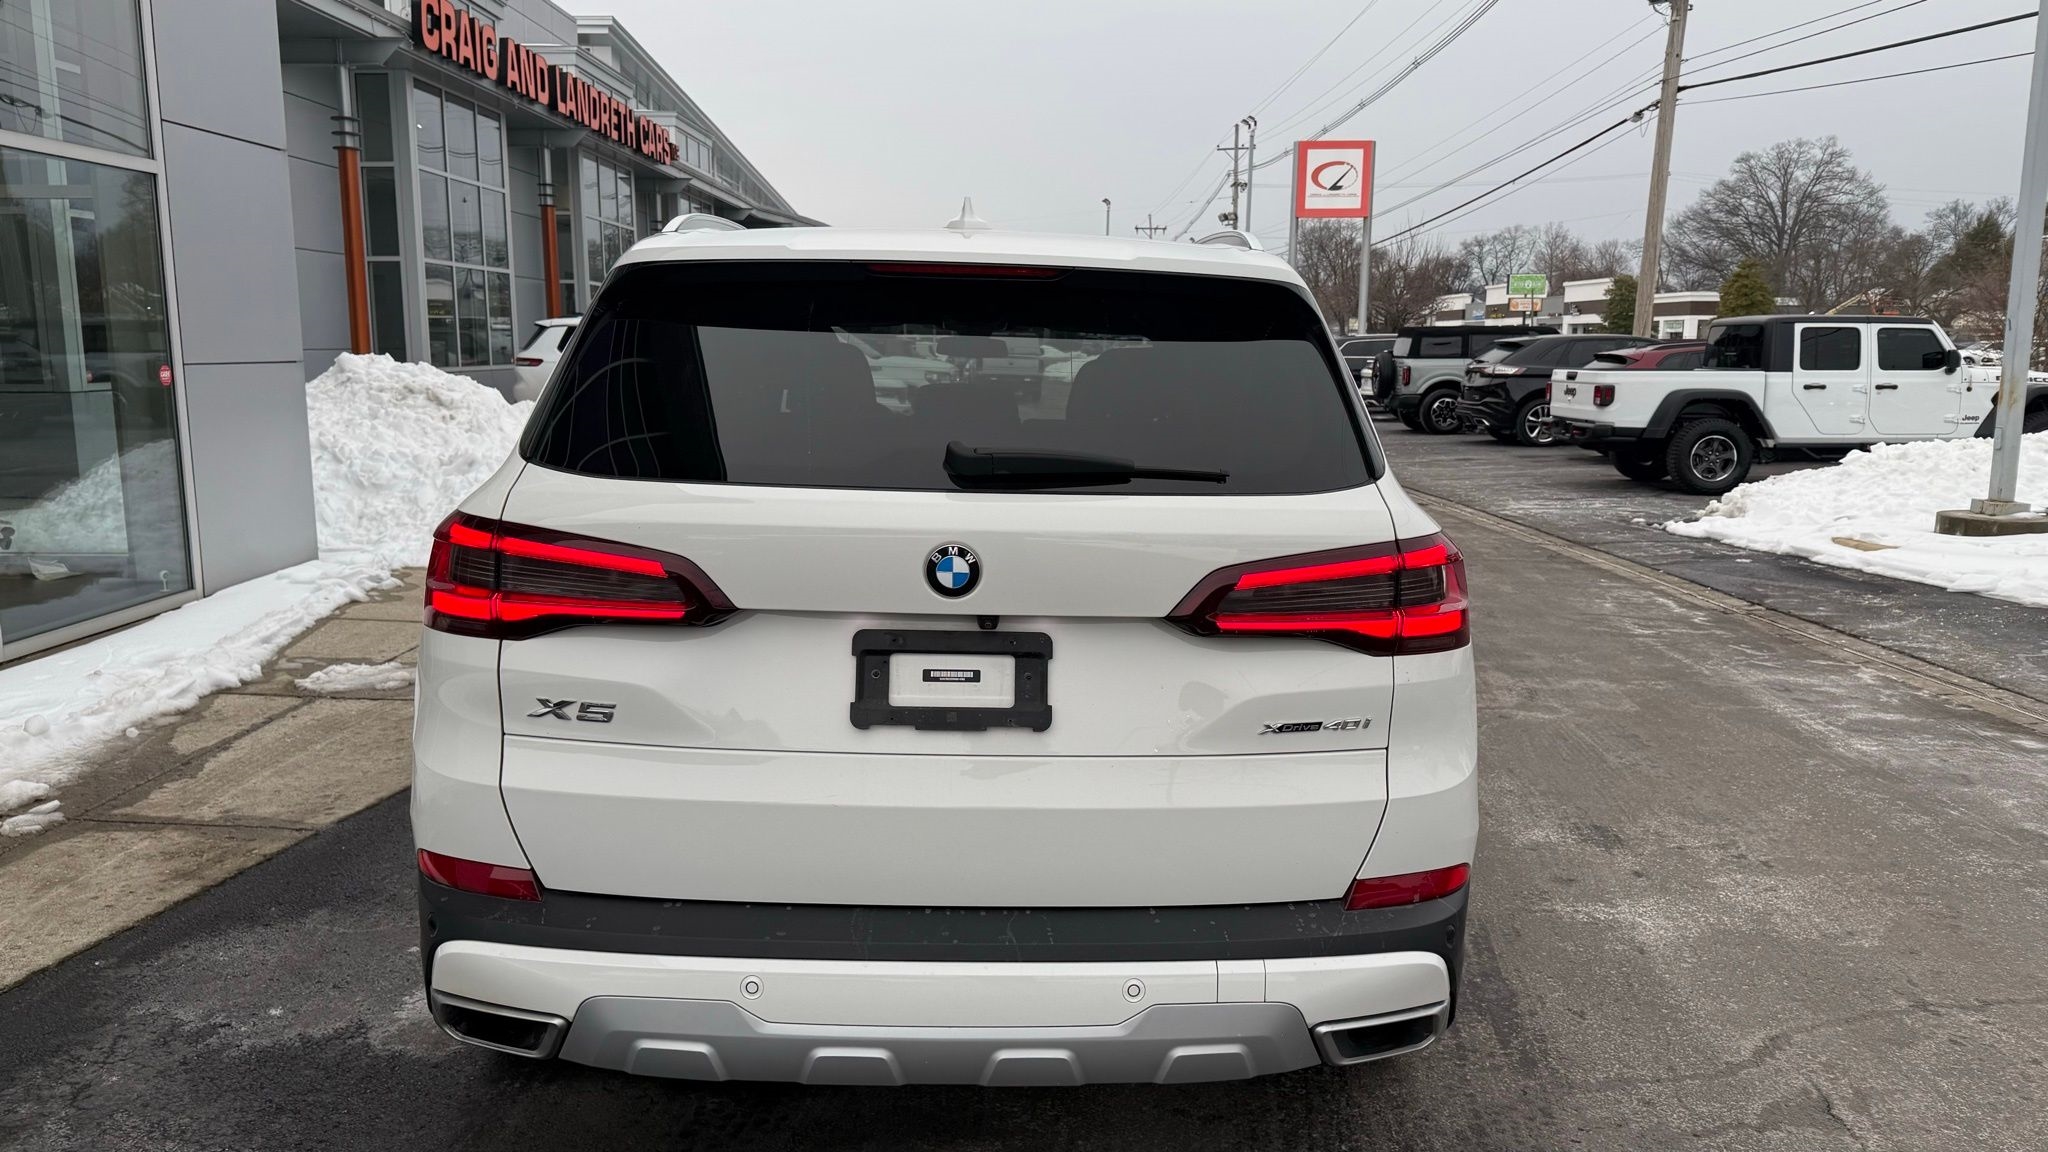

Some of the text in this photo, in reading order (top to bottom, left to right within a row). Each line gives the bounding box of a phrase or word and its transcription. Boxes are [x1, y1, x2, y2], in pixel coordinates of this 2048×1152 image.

[420, 0, 672, 165] CRAIG AND LANDRETH CARS
[1564, 385, 1577, 398] Jeep
[1962, 414, 1980, 422] Jeep
[931, 546, 976, 564] BMW
[527, 697, 617, 723] X5
